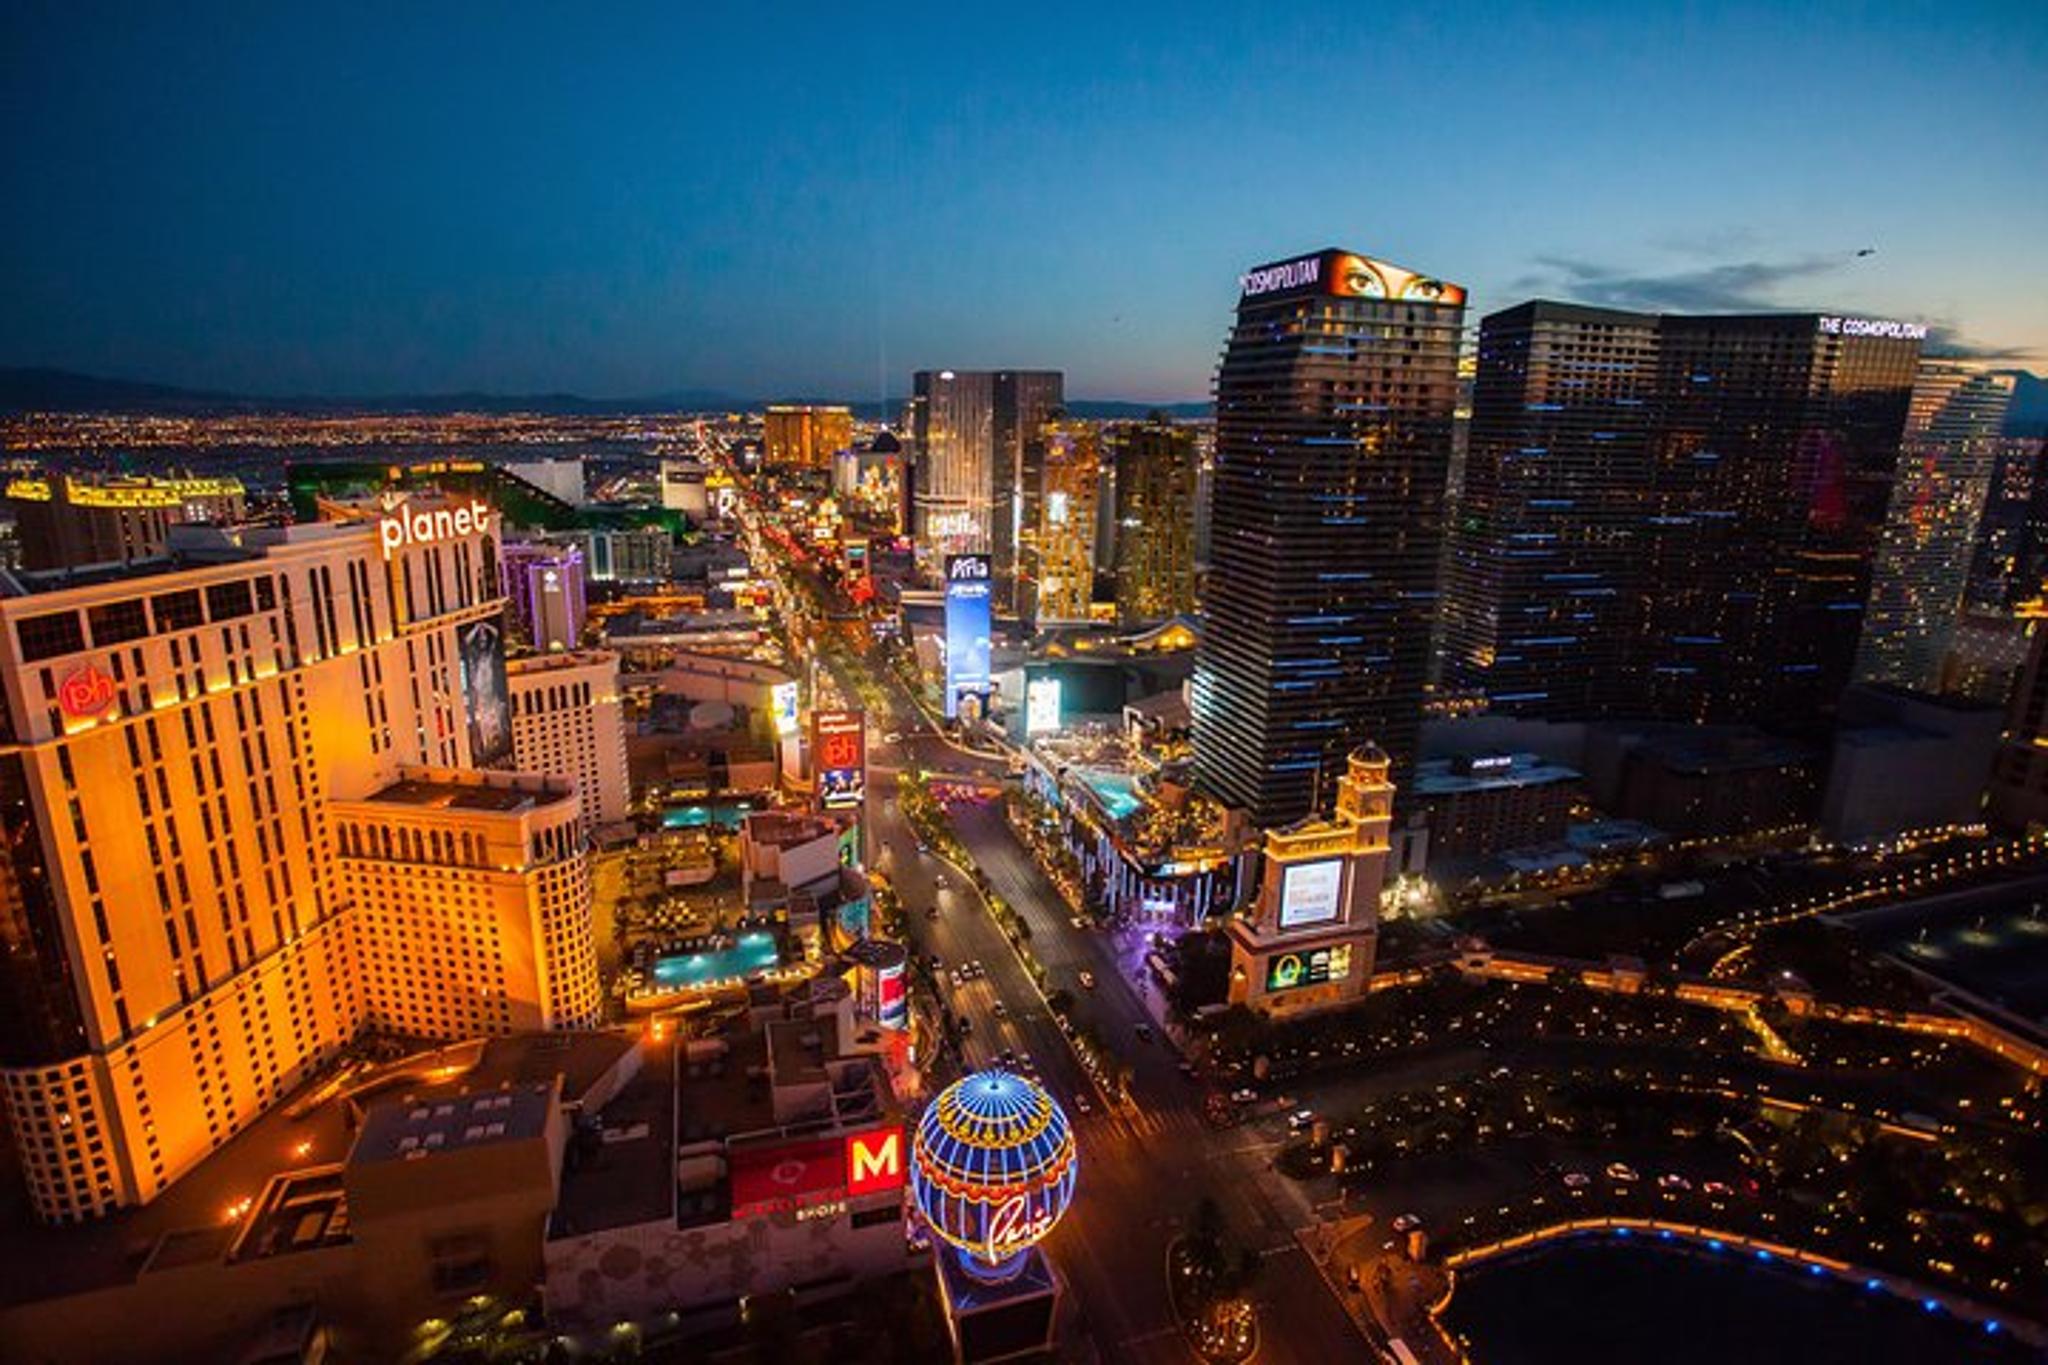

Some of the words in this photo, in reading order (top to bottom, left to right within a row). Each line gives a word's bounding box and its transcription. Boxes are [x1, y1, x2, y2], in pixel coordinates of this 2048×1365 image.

[1245, 257, 1321, 296] COSMOPOLITAN
[1819, 317, 1841, 334] THE
[1842, 319, 1927, 339] COSMOPOLITAN
[381, 499, 489, 561] planet
[852, 1134, 899, 1182] M
[988, 1196, 1053, 1267] Paris
